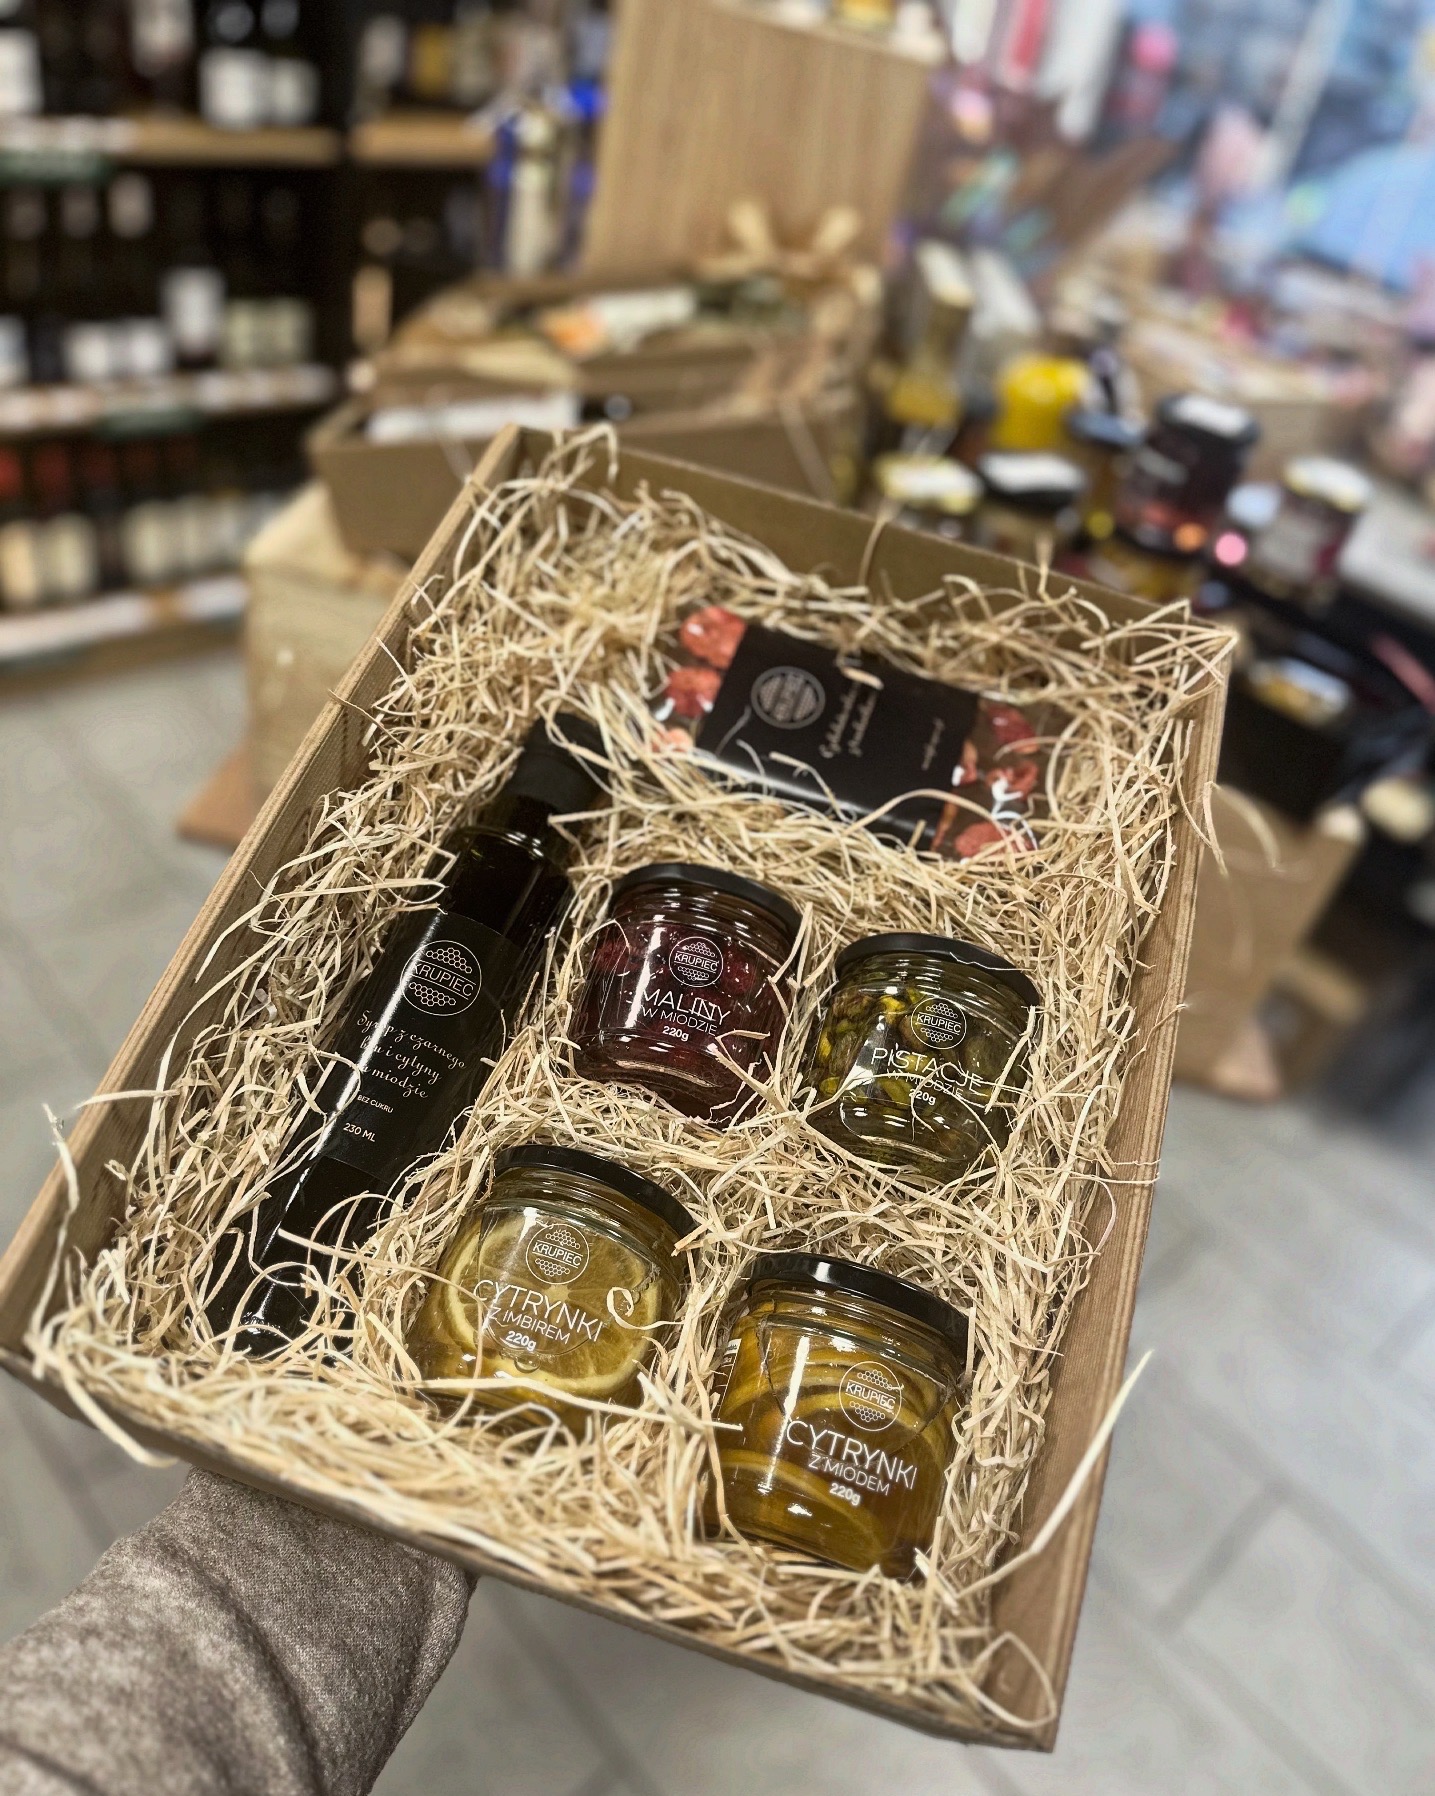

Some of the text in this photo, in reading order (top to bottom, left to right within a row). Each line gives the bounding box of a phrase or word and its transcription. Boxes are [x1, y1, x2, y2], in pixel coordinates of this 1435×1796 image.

[674, 952, 719, 972] KRUPIEC
[412, 963, 474, 997] KRUPIEC
[642, 988, 731, 1025] MALINY
[641, 1005, 718, 1037] W MIODZIE
[662, 1025, 690, 1042] 220g
[916, 1013, 962, 1034] KRUPIEC
[385, 1045, 395, 1057] i
[409, 1034, 467, 1069] czarnego
[371, 1069, 429, 1099] miodzie
[871, 1047, 986, 1097] PISTACJE
[357, 1094, 394, 1114] BEZ CUKRU
[343, 1122, 376, 1143] 230 ML
[533, 1242, 582, 1266] KRUPIEC
[473, 1279, 603, 1342] CYTRYNKI
[489, 1307, 570, 1345] Z IMBIREM
[505, 1330, 537, 1350] 220g
[845, 1382, 896, 1409] KRUPIEC
[786, 1420, 918, 1490] CYTRYNKI
[808, 1453, 890, 1495] Z MIODEM
[829, 1483, 861, 1506] 220g
